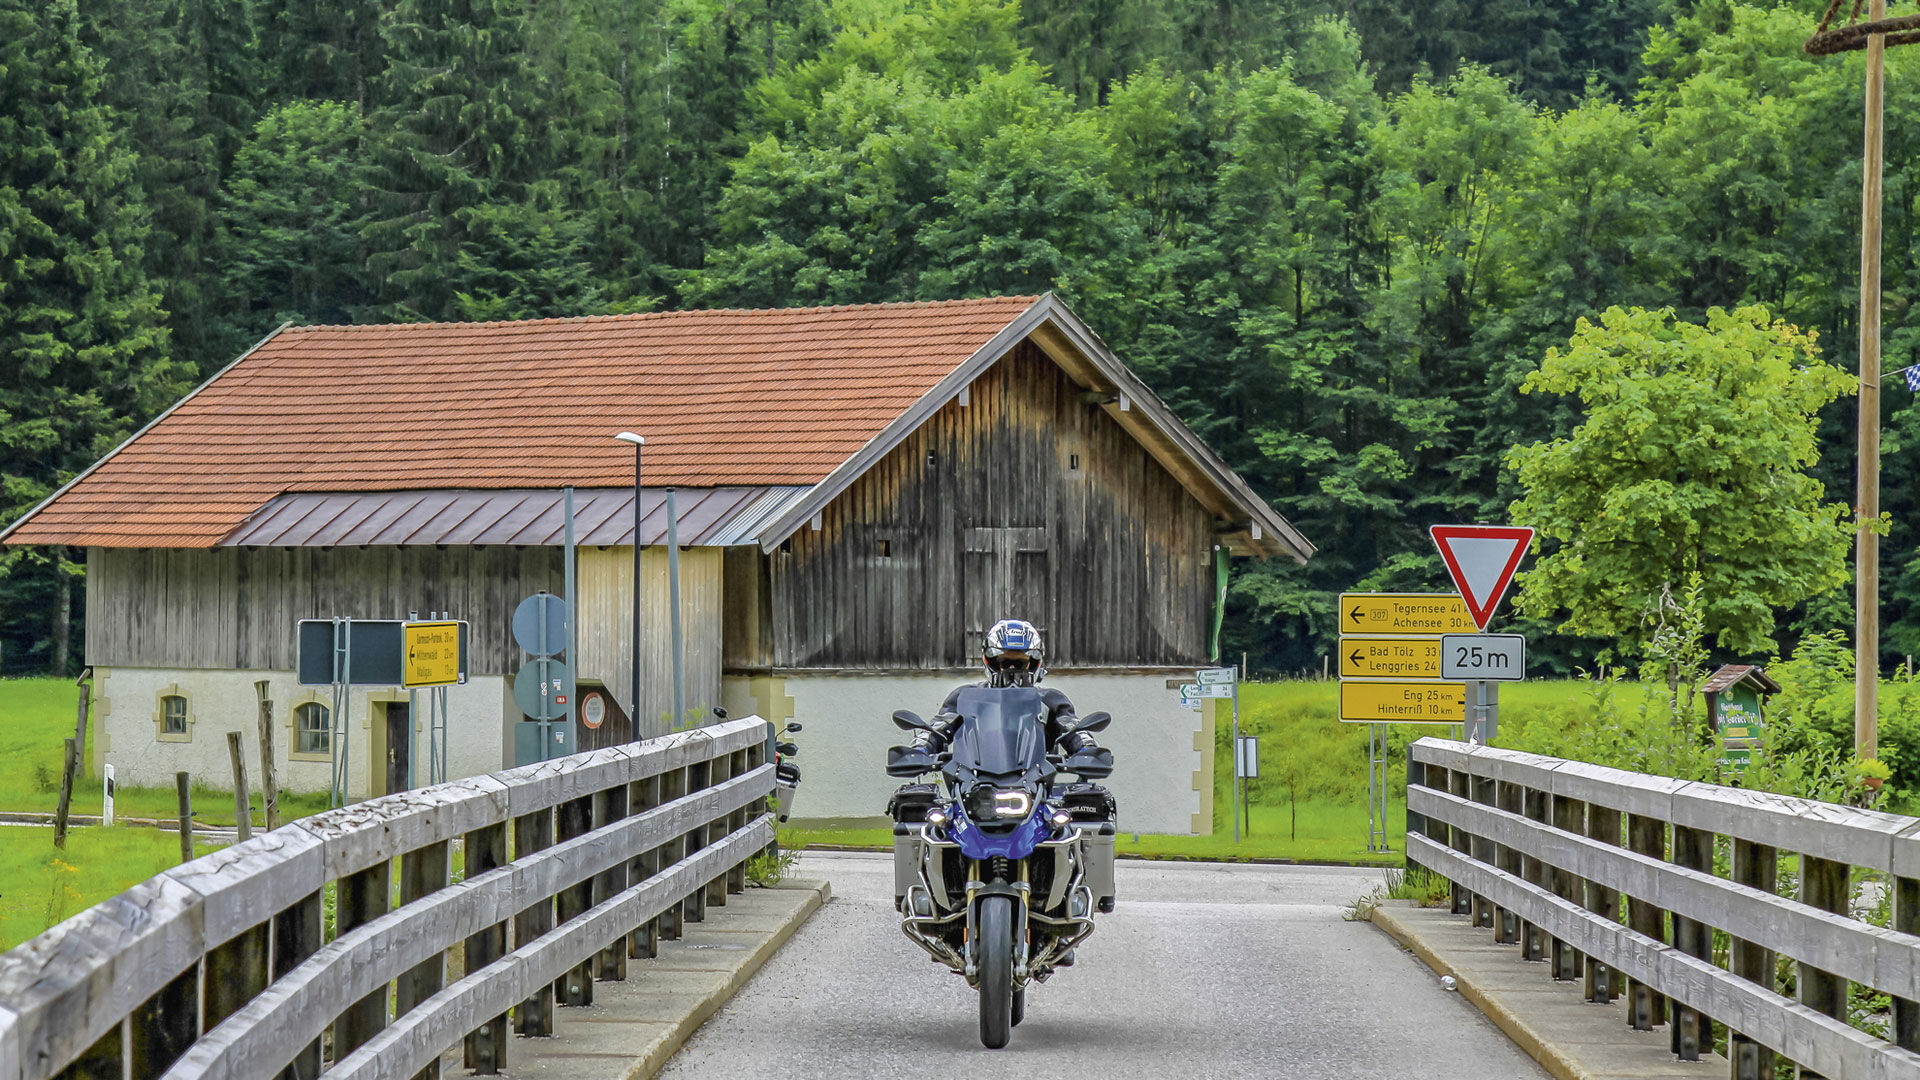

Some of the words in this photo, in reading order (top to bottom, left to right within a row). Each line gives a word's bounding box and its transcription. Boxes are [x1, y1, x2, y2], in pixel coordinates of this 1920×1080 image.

[1393, 602, 1446, 615] Tegernsee
[1450, 603, 1461, 613] 41
[1372, 611, 1386, 619] 307
[1393, 618, 1442, 627] Achensee
[1450, 618, 1462, 628] 30
[1369, 646, 1389, 656] Bad
[1393, 646, 1414, 656] Tölz
[1424, 647, 1437, 656] 33
[1369, 661, 1420, 672] Lenggries
[1424, 661, 1436, 671] 24
[1404, 690, 1422, 702] Eng
[1427, 690, 1438, 700] 25
[1378, 704, 1422, 714] Hinterriß
[1428, 704, 1438, 714] 10
